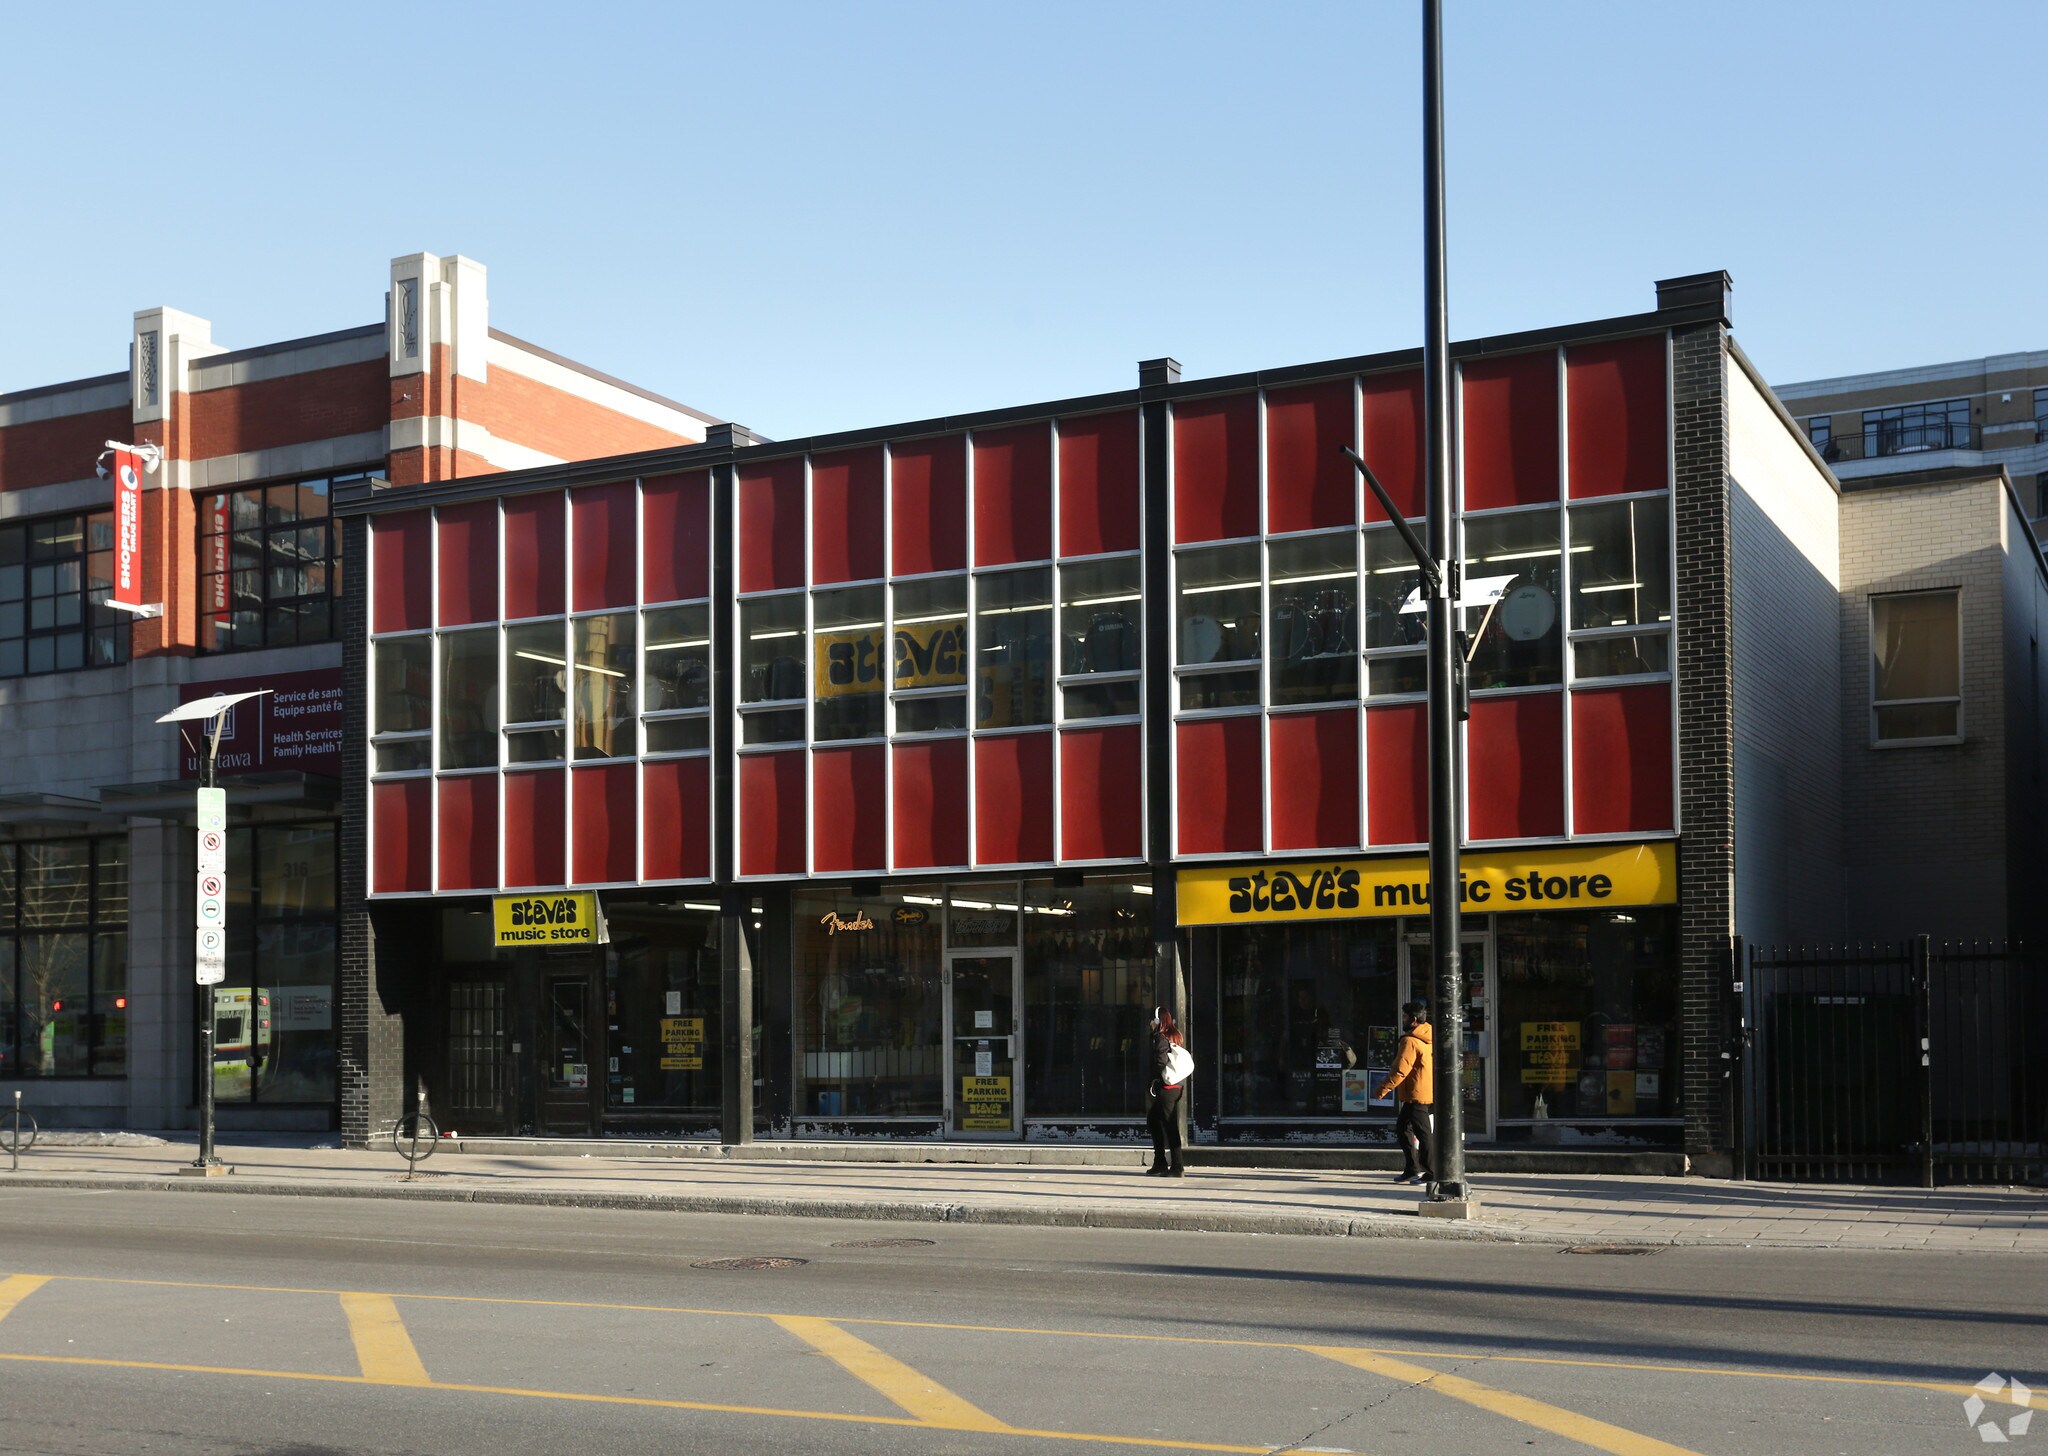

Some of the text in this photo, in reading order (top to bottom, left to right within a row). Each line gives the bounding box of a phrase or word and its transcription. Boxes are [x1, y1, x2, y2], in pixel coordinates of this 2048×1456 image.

[120, 490, 131, 589] SHOPPERS
[273, 688, 343, 703] Service de sant
[273, 704, 305, 718] Equipe
[306, 701, 331, 714] santé
[273, 728, 343, 744] Health Services
[273, 744, 303, 758] Family
[305, 741, 334, 755] Health
[1374, 872, 1491, 906] muic
[1504, 871, 1613, 901] store
[820, 910, 874, 935] Fender
[501, 927, 590, 941] music store
[1537, 1024, 1565, 1032] FREE
[1526, 1034, 1576, 1043] PARKING
